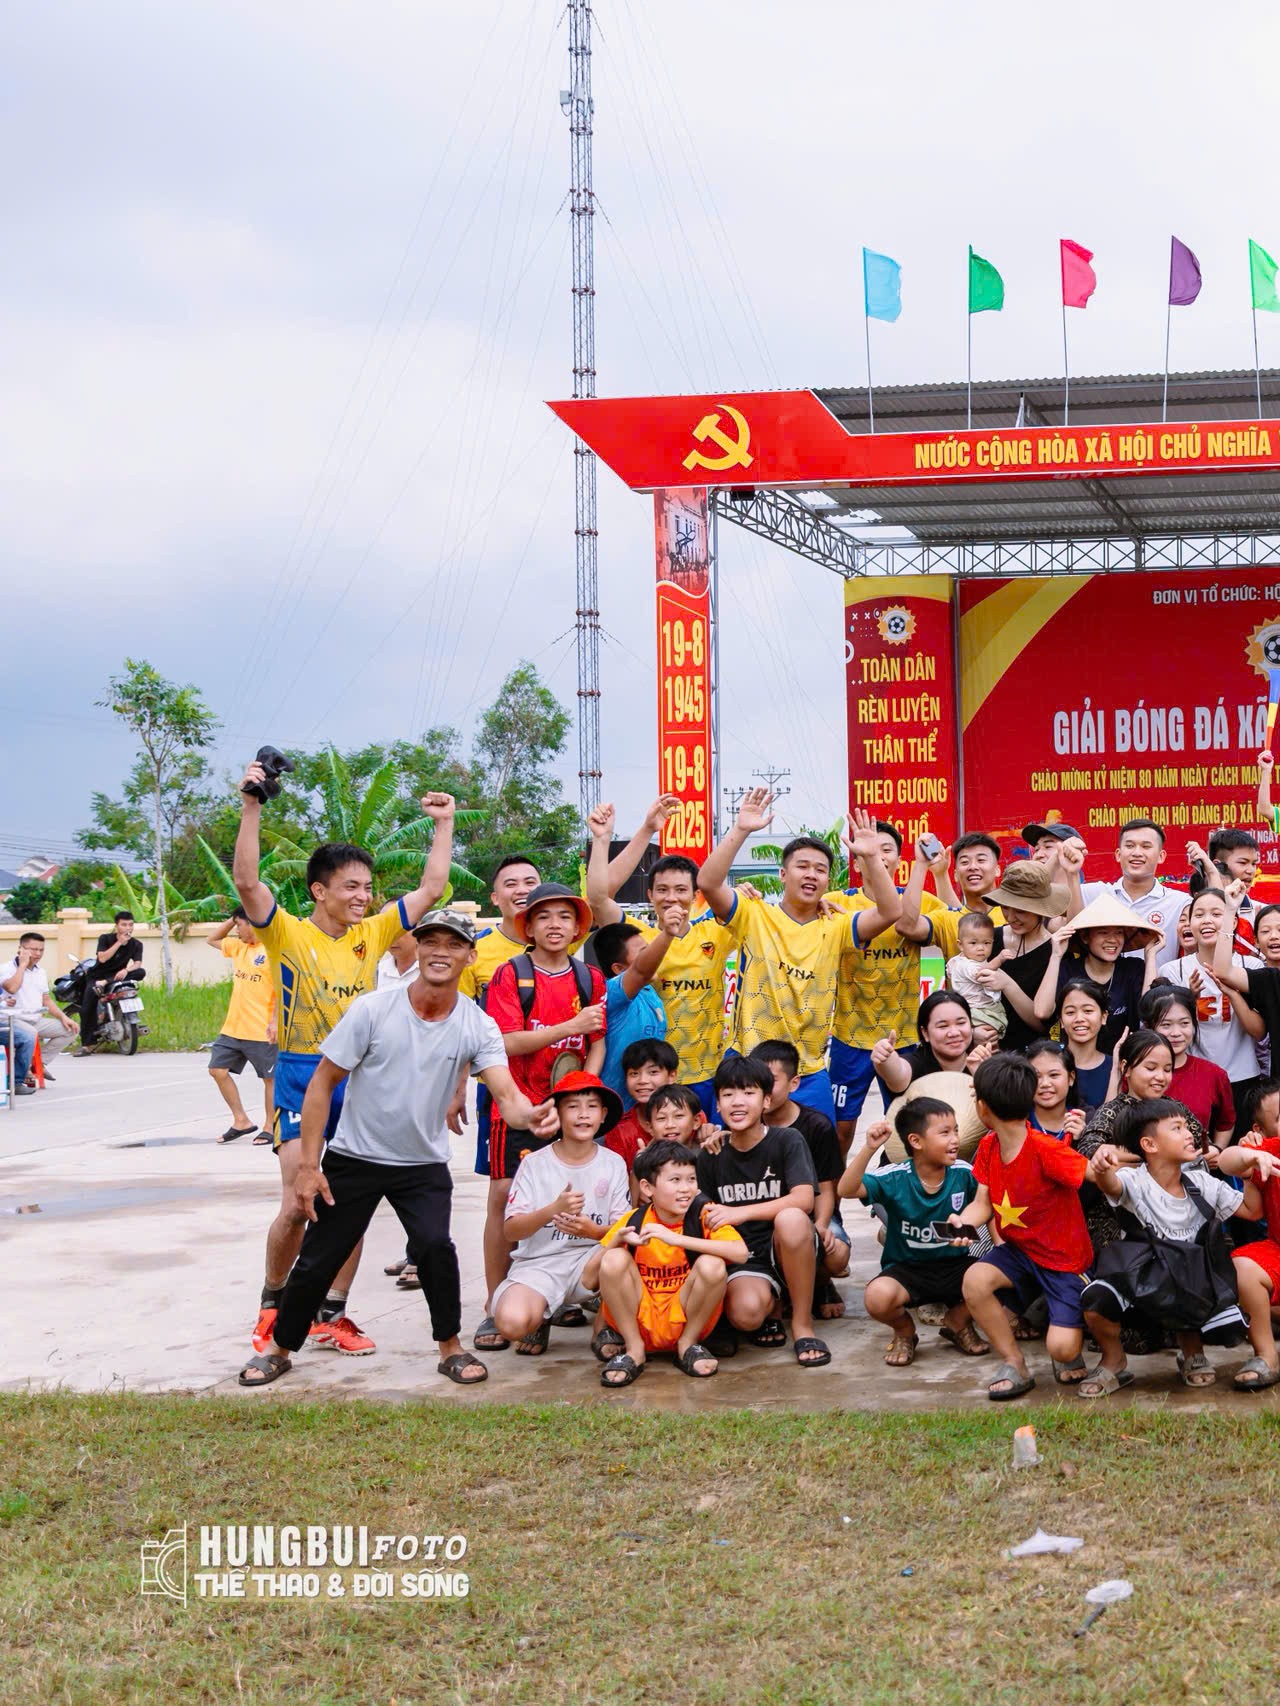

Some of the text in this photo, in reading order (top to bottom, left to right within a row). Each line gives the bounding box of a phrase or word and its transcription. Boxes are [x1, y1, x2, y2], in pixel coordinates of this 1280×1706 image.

[915, 435, 970, 469] NƯỚC
[976, 435, 1032, 471] CỘNG
[1038, 432, 1079, 464] HÒA
[1085, 432, 1113, 462] XÃ
[1119, 430, 1154, 466] HỘI
[1160, 424, 1200, 459] CHỦ
[1207, 426, 1271, 458] NGHĨA
[1153, 589, 1181, 605] ĐƠN
[1184, 589, 1198, 606] VỊ
[1201, 582, 1219, 603] TỔ
[1221, 584, 1261, 602] CHỨC:
[663, 619, 704, 667] 19-8
[860, 651, 936, 683] TOÀN DÂN
[664, 675, 704, 723] 1945
[858, 691, 941, 727] RÈN LUYỆN
[1053, 697, 1105, 755] GIẢI
[1115, 699, 1185, 753] BÓNG
[1194, 697, 1230, 750] ĐÁ
[1238, 695, 1270, 749] XÃ
[863, 727, 938, 764] THÂN THỂ
[664, 745, 705, 793] 19-8
[1031, 766, 1058, 792] CHÀO
[1061, 767, 1092, 791] MỪNG
[1094, 763, 1108, 790] KỶ
[1110, 765, 1137, 793] NIỆM
[1139, 769, 1151, 789] 80
[1154, 764, 1178, 788] NĂM
[1181, 764, 1208, 788] NGÀY
[1211, 762, 1238, 787] CÁCH
[854, 777, 948, 805] THEO GƯƠNG
[665, 800, 705, 848] 2025
[1088, 803, 1116, 828] CHÀO
[1152, 806, 1169, 828] ĐẠI
[1172, 801, 1189, 830] HỘI
[1192, 799, 1220, 824] ĐẢNG
[1223, 800, 1237, 828] BỘ
[1239, 800, 1254, 823] XÃ
[863, 947, 910, 960] FYNAL
[661, 979, 711, 992] FYNAL
[778, 962, 816, 980] FYNA
